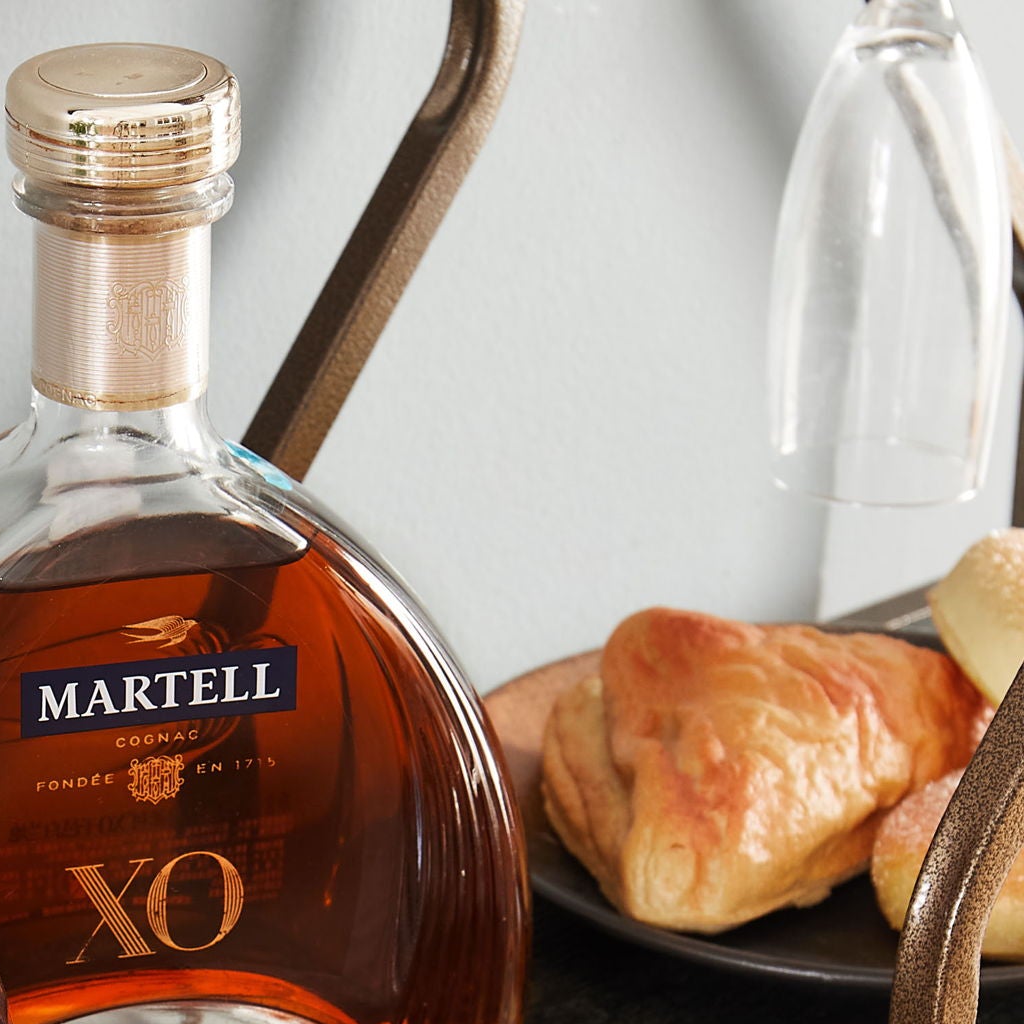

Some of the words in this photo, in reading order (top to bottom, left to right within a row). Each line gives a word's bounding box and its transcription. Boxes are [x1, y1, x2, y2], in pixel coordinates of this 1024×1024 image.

[38, 662, 281, 722] MARTELL
[115, 729, 199, 749] COGNAC
[36, 772, 115, 793] FONDÉE
[196, 761, 223, 775] EN
[65, 851, 244, 965] XO
